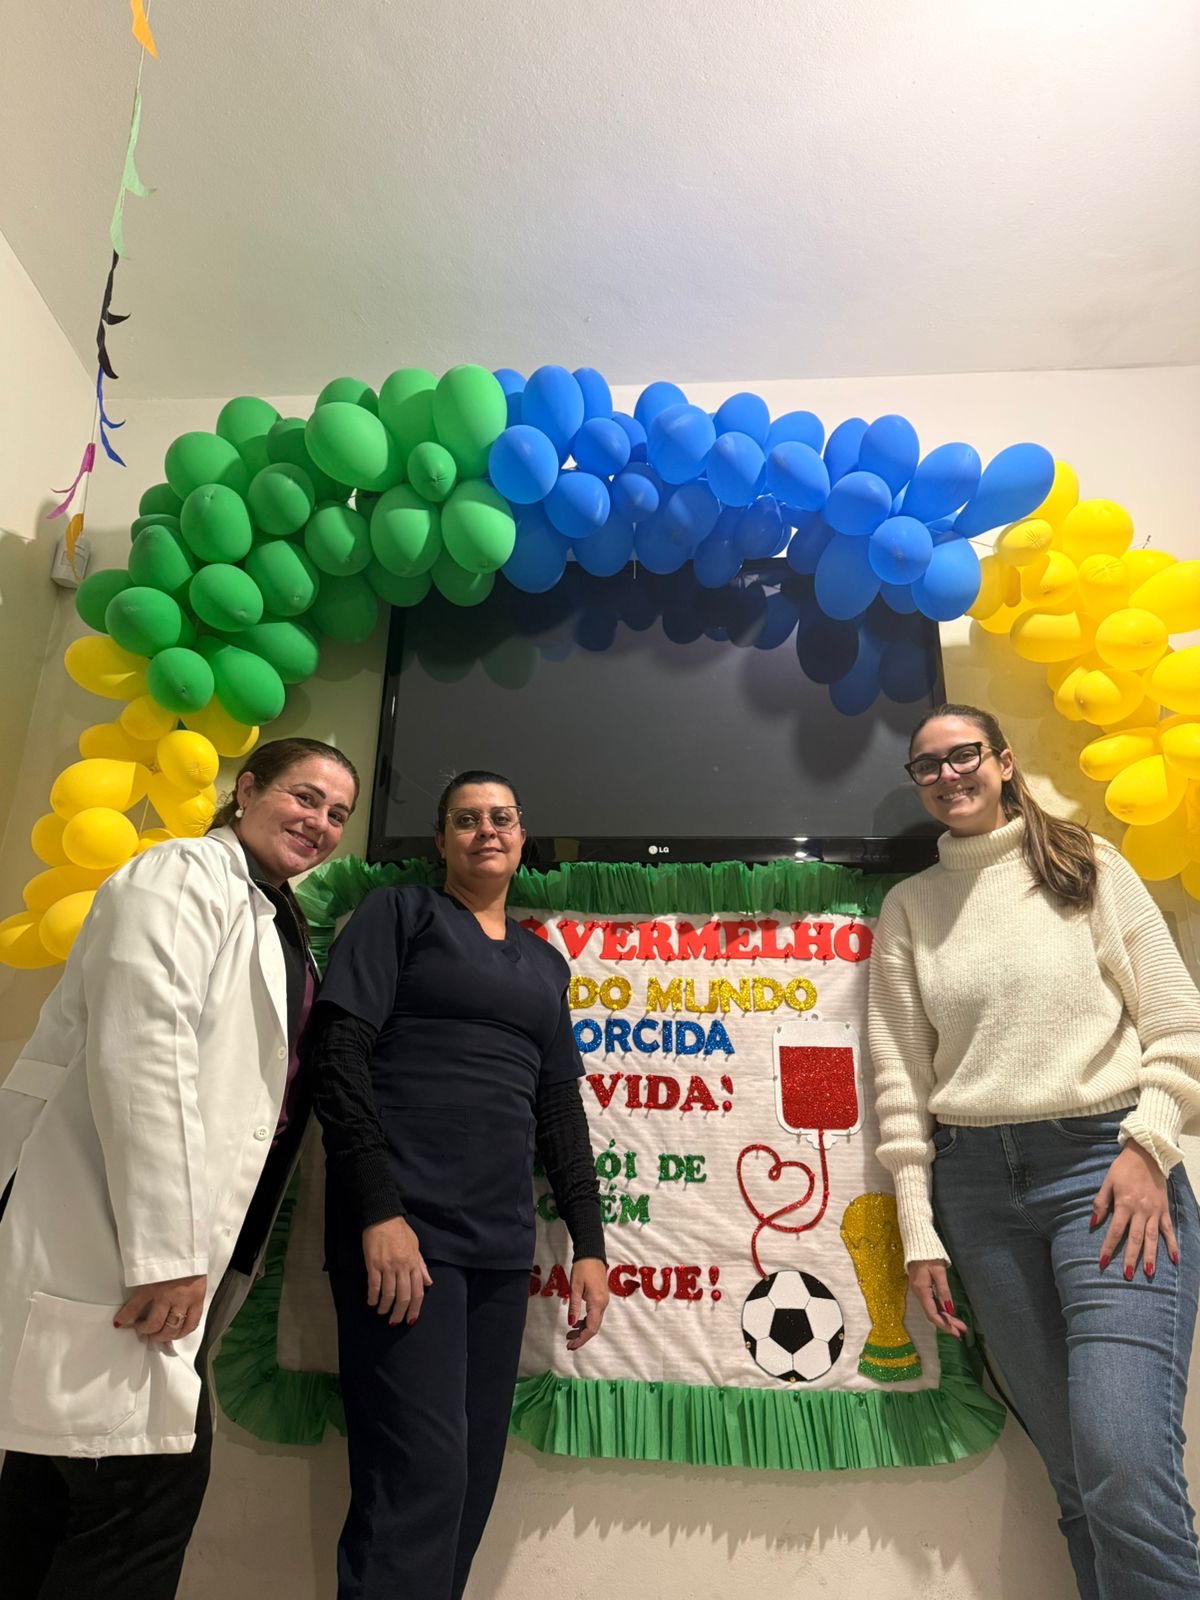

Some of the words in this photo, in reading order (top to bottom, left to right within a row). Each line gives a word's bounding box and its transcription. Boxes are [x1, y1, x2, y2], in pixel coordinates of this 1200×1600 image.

[557, 918, 874, 962] VERMELHO
[568, 976, 632, 1011] DO
[646, 977, 817, 1013] MUNDO
[571, 1018, 735, 1055] ORCIDA
[586, 1072, 734, 1112] VIDA!
[658, 1154, 707, 1183] DE
